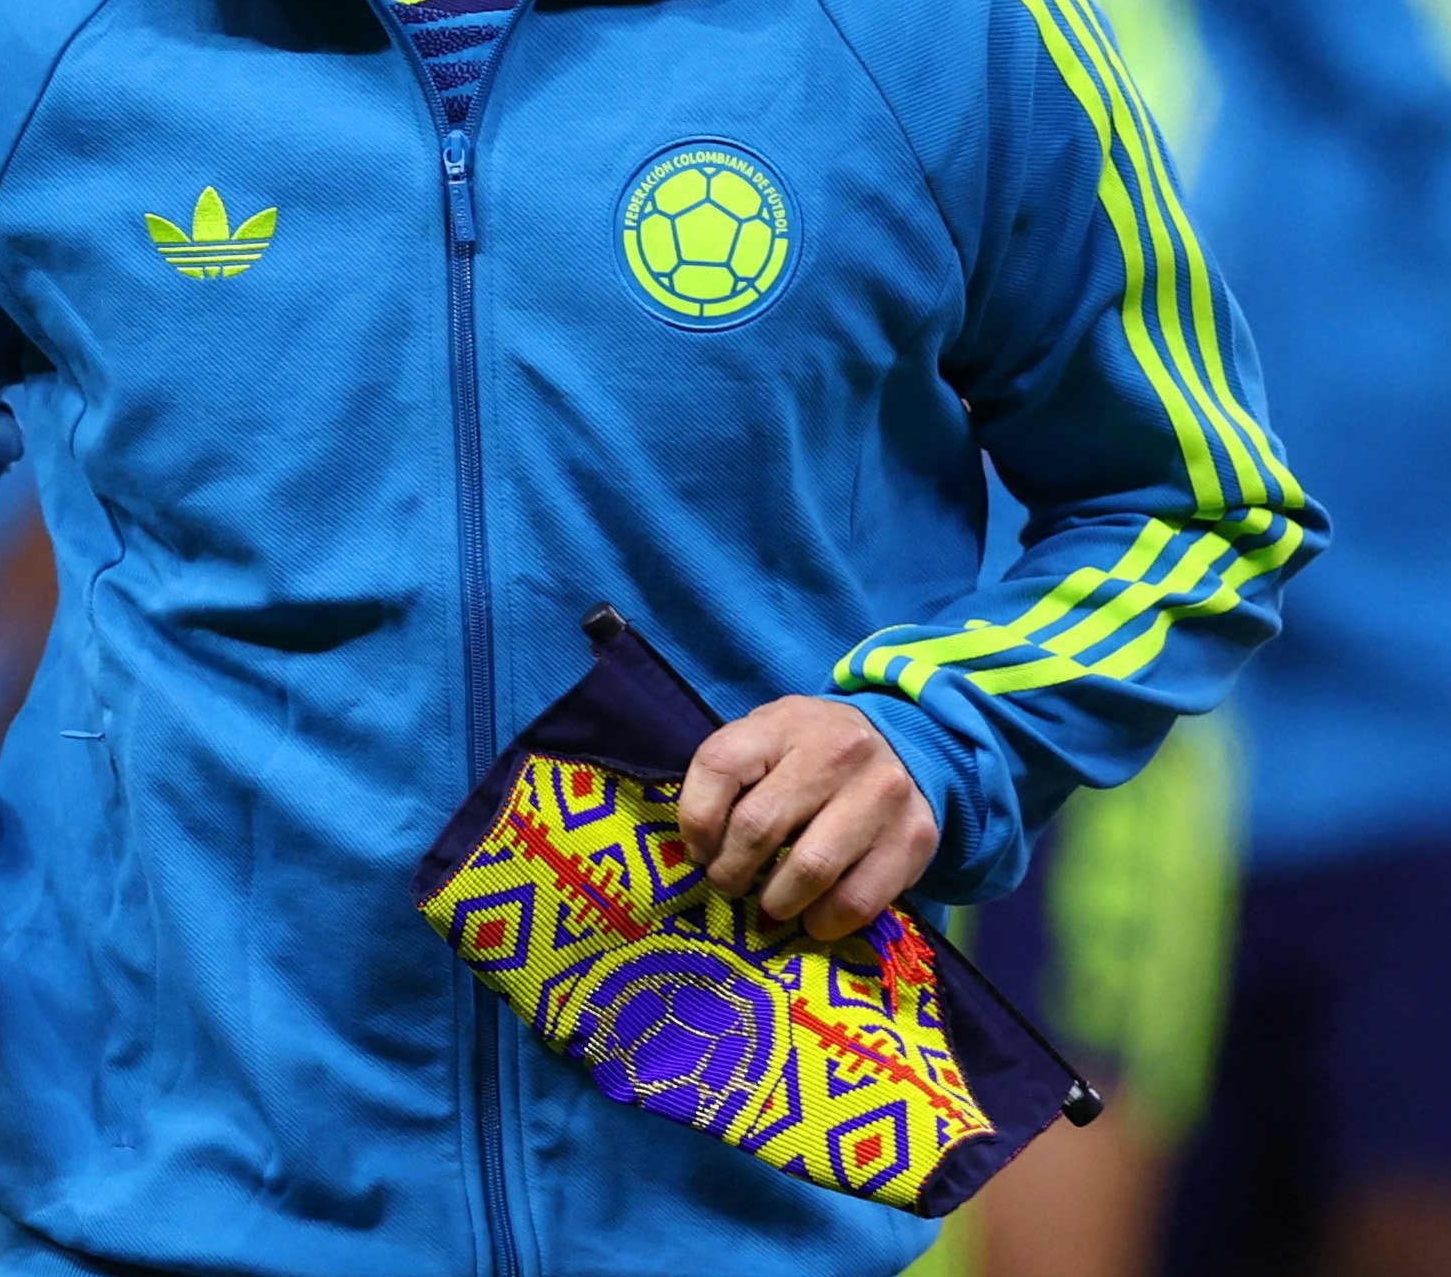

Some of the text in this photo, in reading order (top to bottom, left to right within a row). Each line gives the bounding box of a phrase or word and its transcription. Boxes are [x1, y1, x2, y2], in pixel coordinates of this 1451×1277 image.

[624, 151, 788, 235] FEDERACIÓN COLOMBIANA DE FÚTBOL
